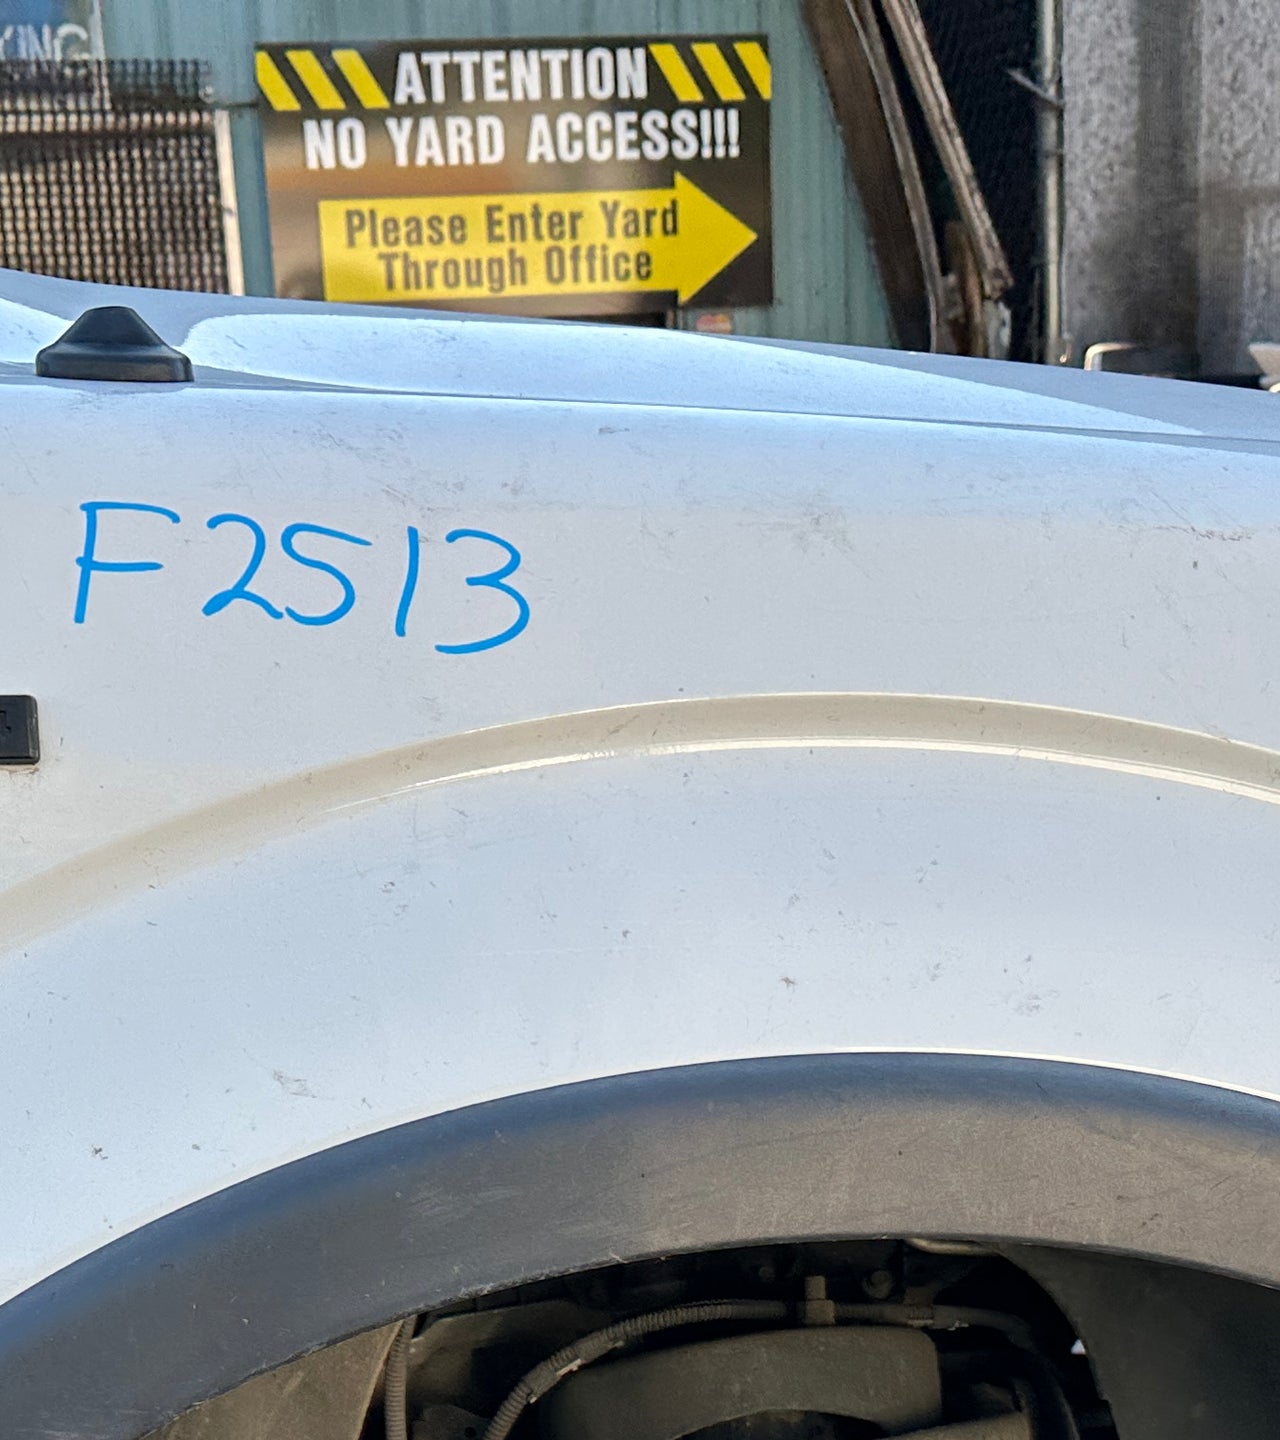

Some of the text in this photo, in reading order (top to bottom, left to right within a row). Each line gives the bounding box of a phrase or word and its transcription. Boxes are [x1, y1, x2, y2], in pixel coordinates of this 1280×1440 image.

[394, 47, 648, 104] ATTENTION
[303, 109, 741, 169] NO YARD ACCESS!!!
[345, 199, 678, 248] Please Enter Yard
[378, 246, 652, 293] Through Office
[74, 501, 531, 654] F2513
